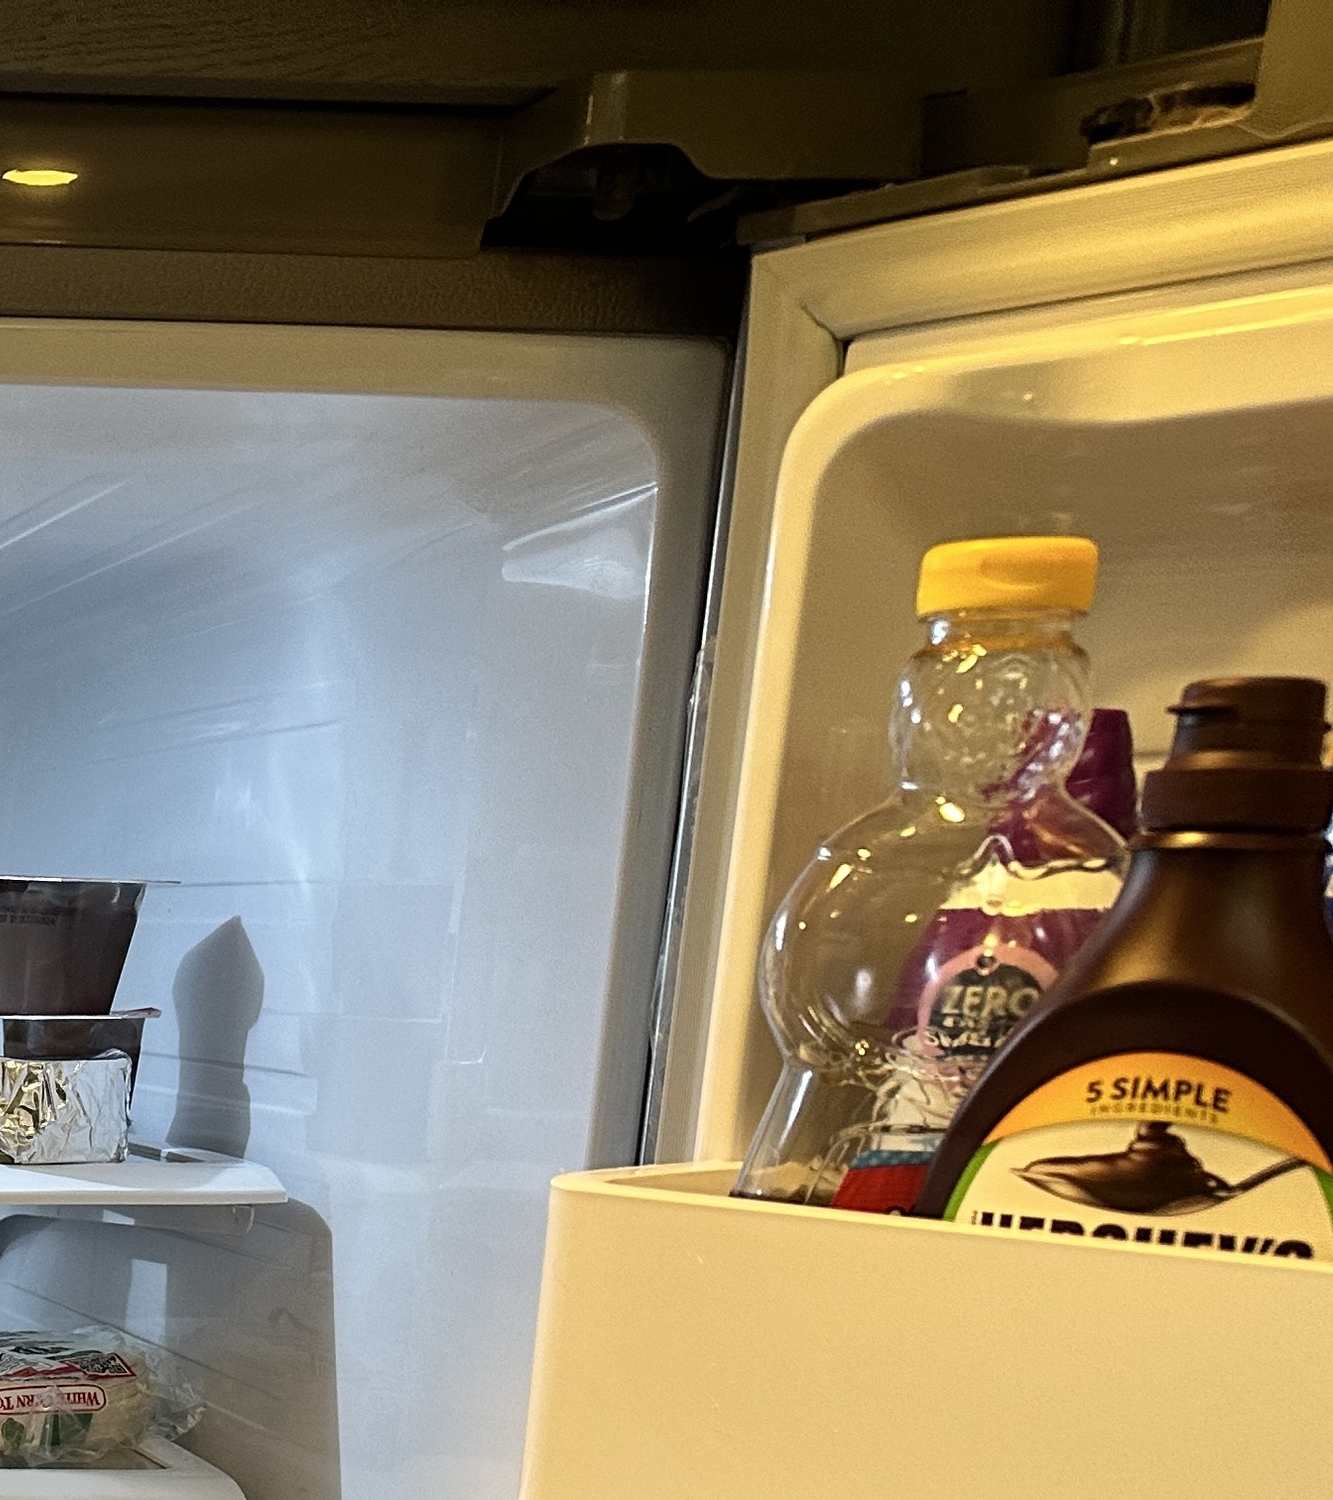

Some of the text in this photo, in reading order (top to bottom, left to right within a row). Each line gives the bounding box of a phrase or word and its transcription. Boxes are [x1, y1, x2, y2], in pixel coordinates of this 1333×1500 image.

[941, 984, 1039, 1016] ZERO
[1086, 1076, 1231, 1112] 5 SIMPLE
[1090, 1103, 1219, 1124] INGREDIENTS
[63, 1390, 102, 1407] WHIT
